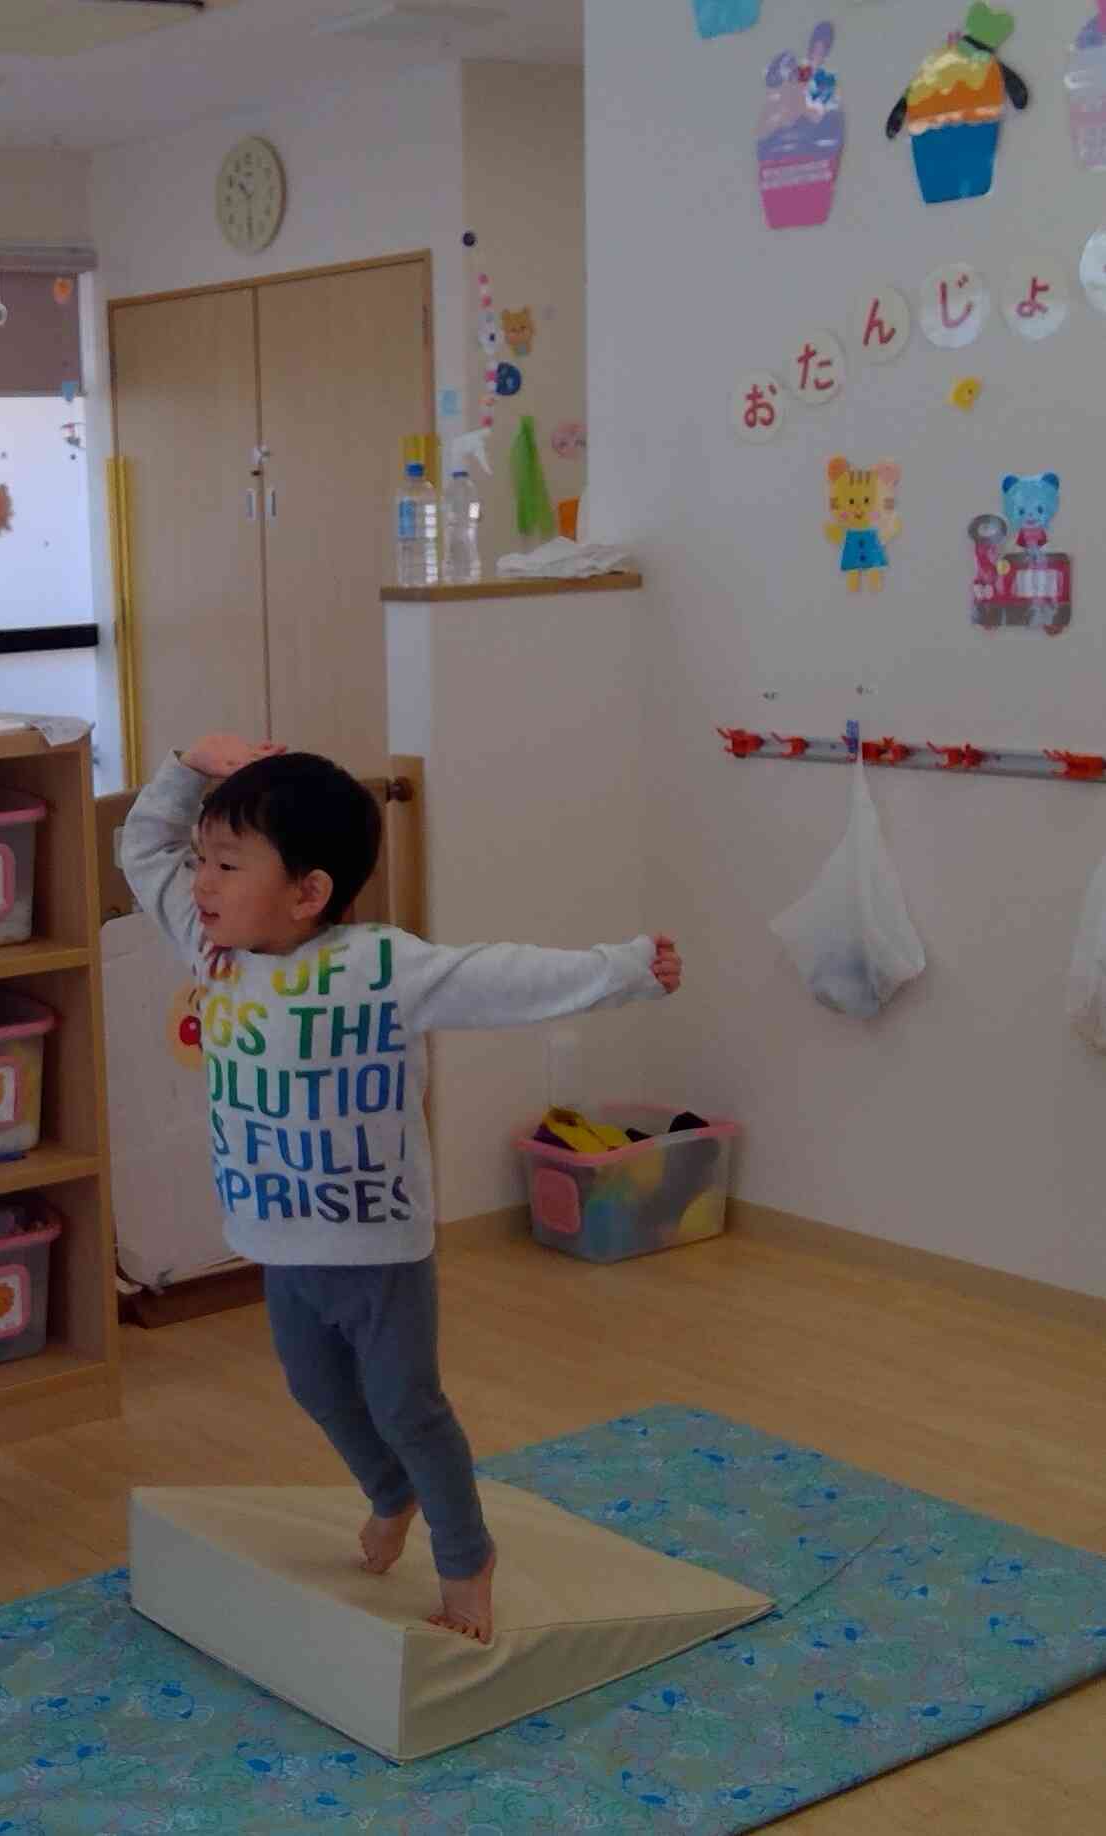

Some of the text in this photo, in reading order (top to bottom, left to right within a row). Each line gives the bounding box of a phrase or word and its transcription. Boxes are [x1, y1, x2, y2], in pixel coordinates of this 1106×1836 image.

[288, 1001, 406, 1059] THE
[245, 1118, 386, 1175] FULL
[214, 1167, 411, 1224] PRISES
